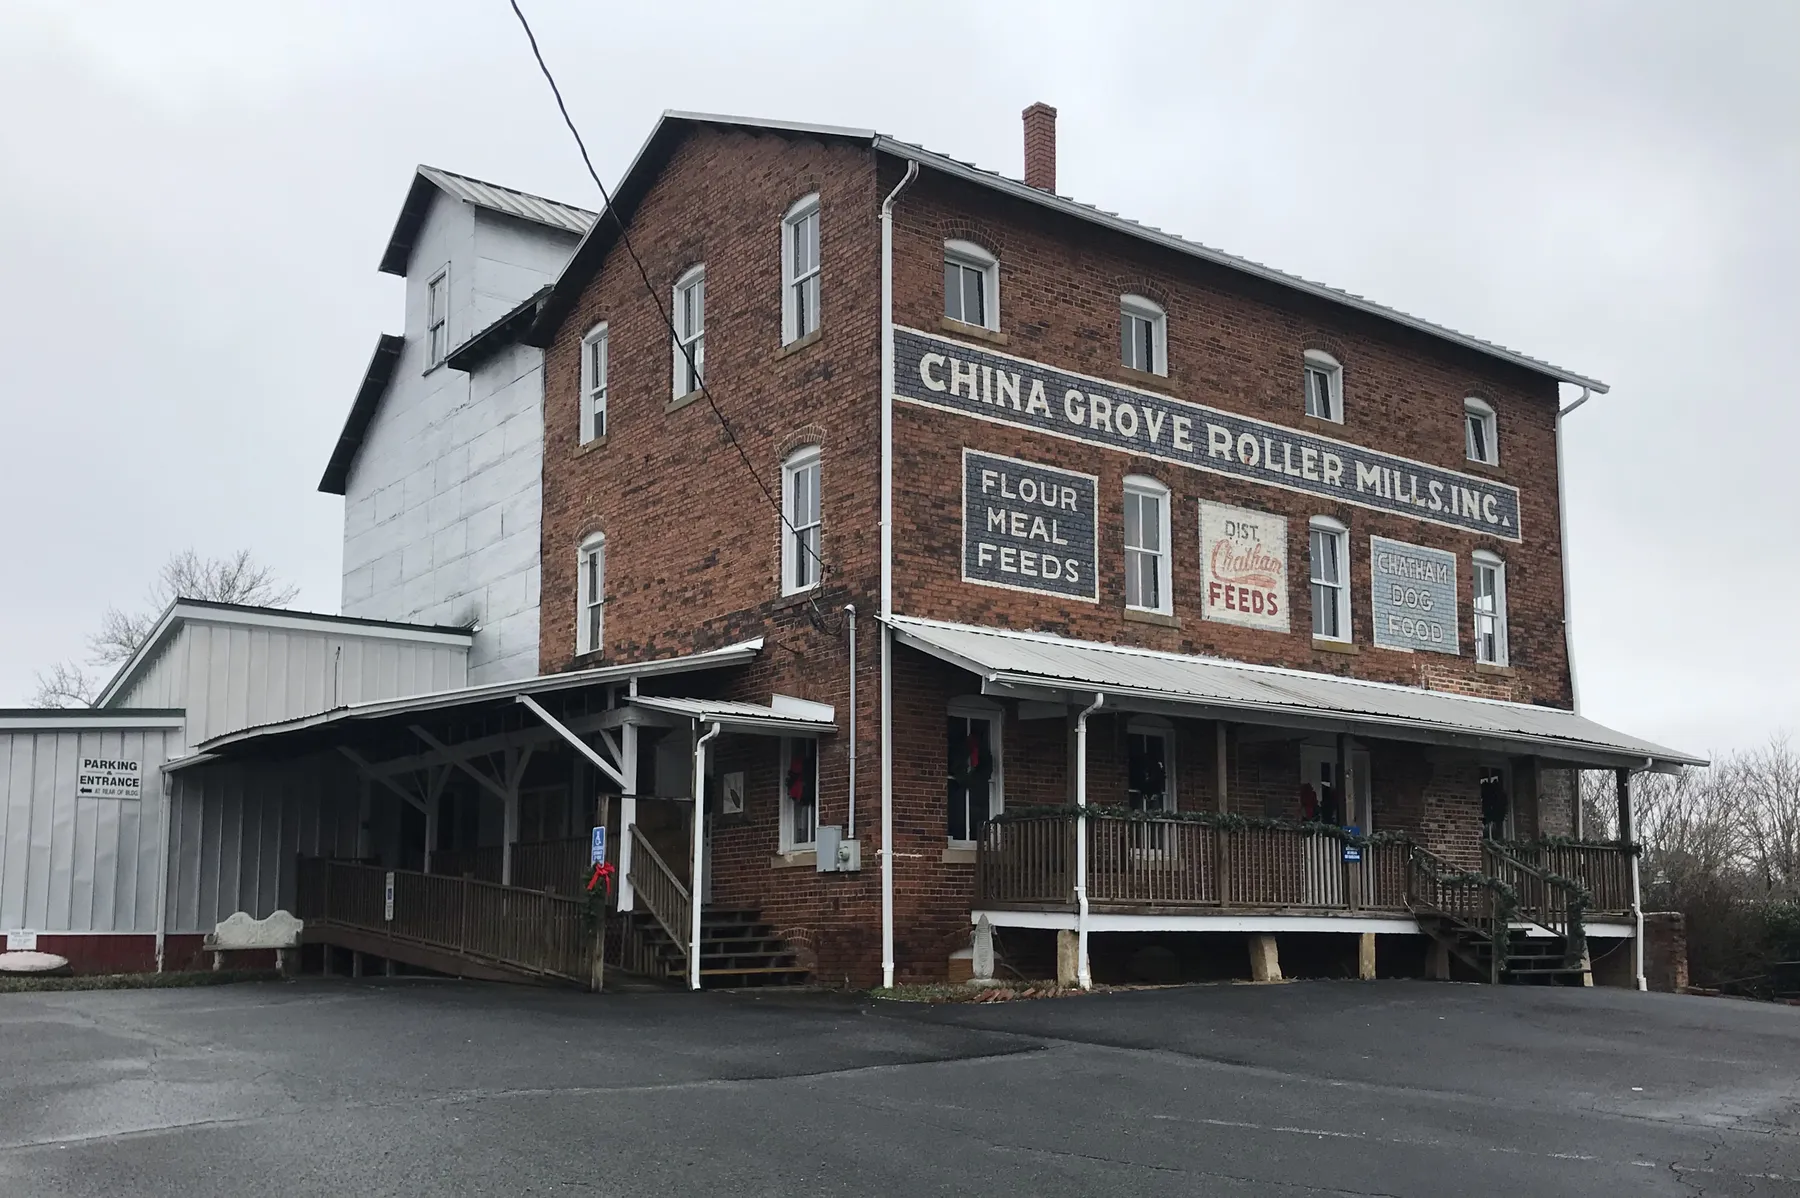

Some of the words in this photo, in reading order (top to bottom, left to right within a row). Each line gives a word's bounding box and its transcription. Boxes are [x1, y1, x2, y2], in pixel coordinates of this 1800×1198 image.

[919, 352, 1052, 418] CHINA
[1064, 389, 1194, 452] GROVE
[1206, 423, 1344, 486] ROLLER
[982, 469, 1078, 512] FLOUR
[987, 506, 1068, 545] MEAL
[1225, 520, 1260, 542] DIST.
[978, 542, 1079, 583] FEEDS
[1211, 539, 1283, 588] Chatham
[1377, 552, 1448, 584] CHATHAM
[1209, 581, 1278, 616] FEEDS
[1391, 584, 1434, 611] DOG
[1388, 614, 1443, 643] FOOD
[80, 775, 140, 787] ENTRANCE
[84, 759, 138, 771] PARKING
